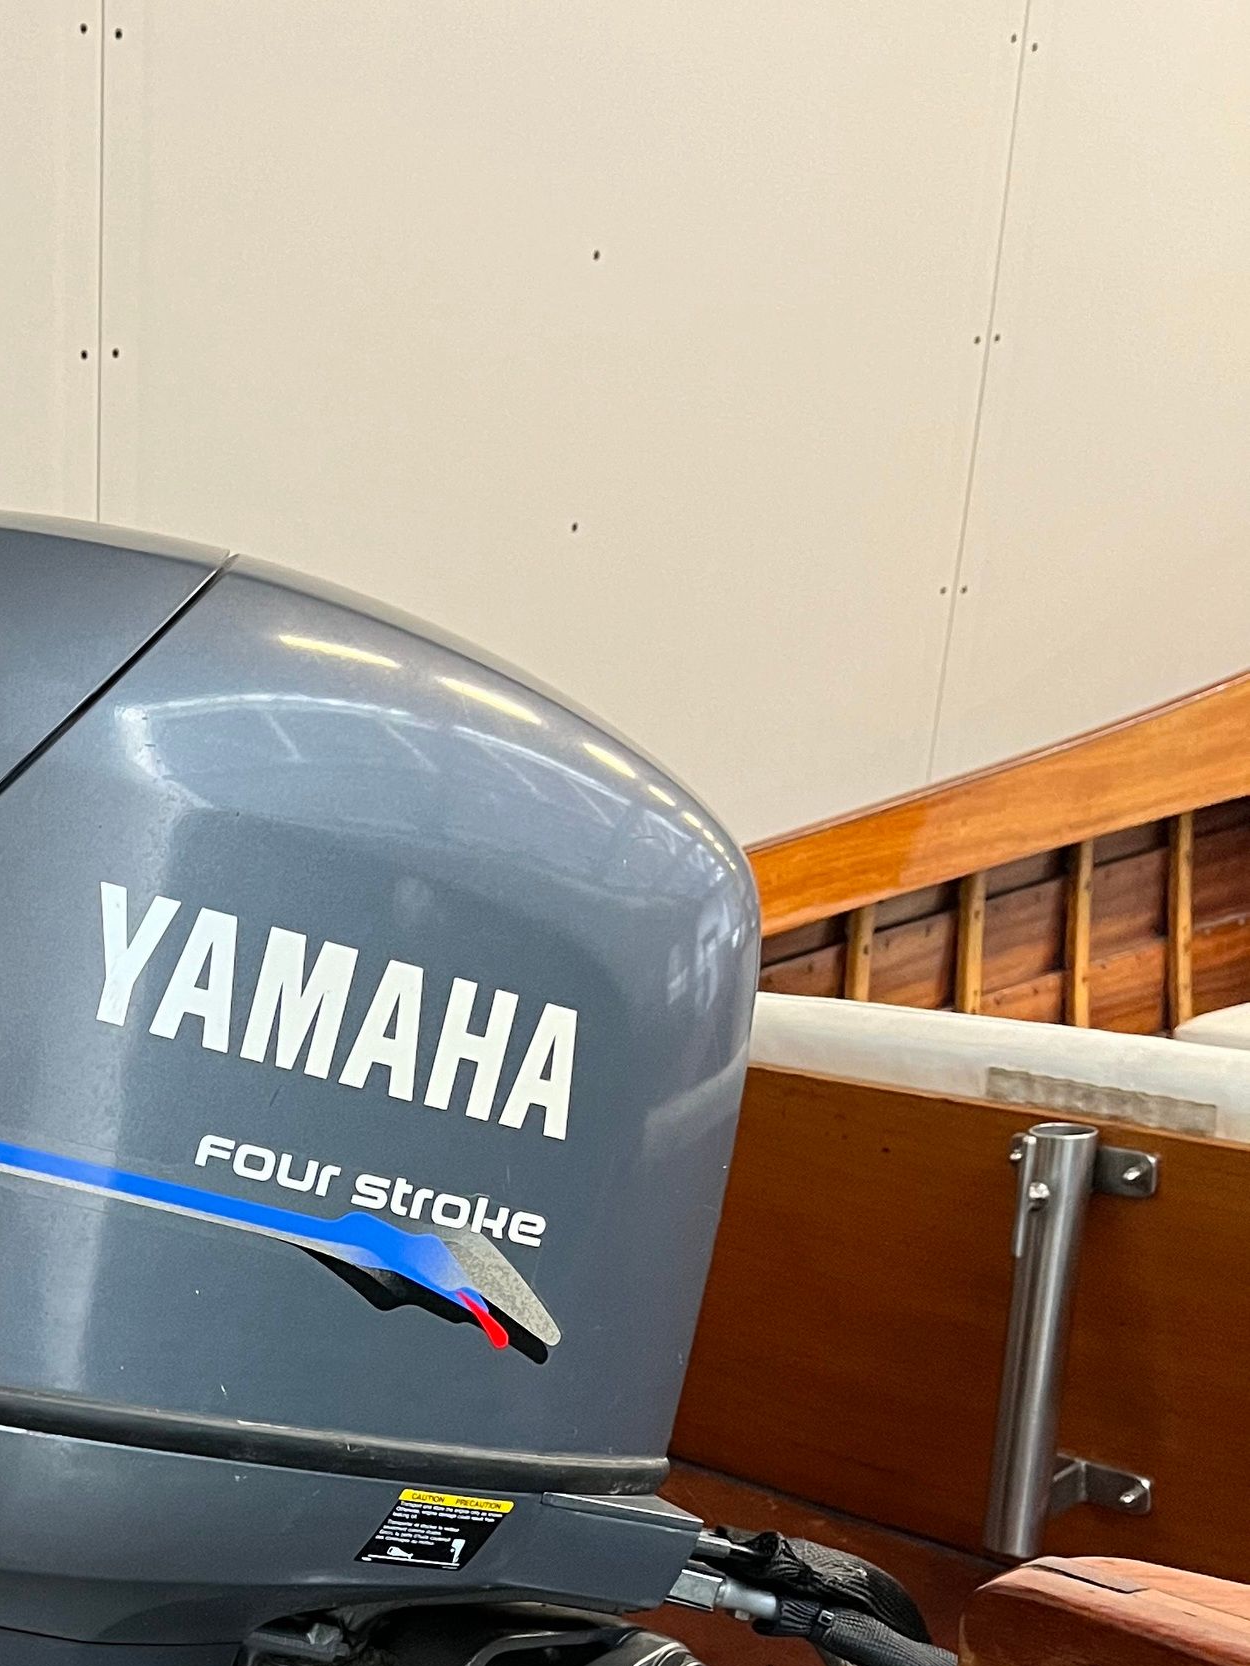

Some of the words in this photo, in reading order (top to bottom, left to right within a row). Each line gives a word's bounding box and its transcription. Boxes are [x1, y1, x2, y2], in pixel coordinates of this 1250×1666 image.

[96, 881, 577, 1140] YAMAHA
[411, 1493, 445, 1503] CAUTION
[455, 1499, 502, 1509] PRECAUTION
